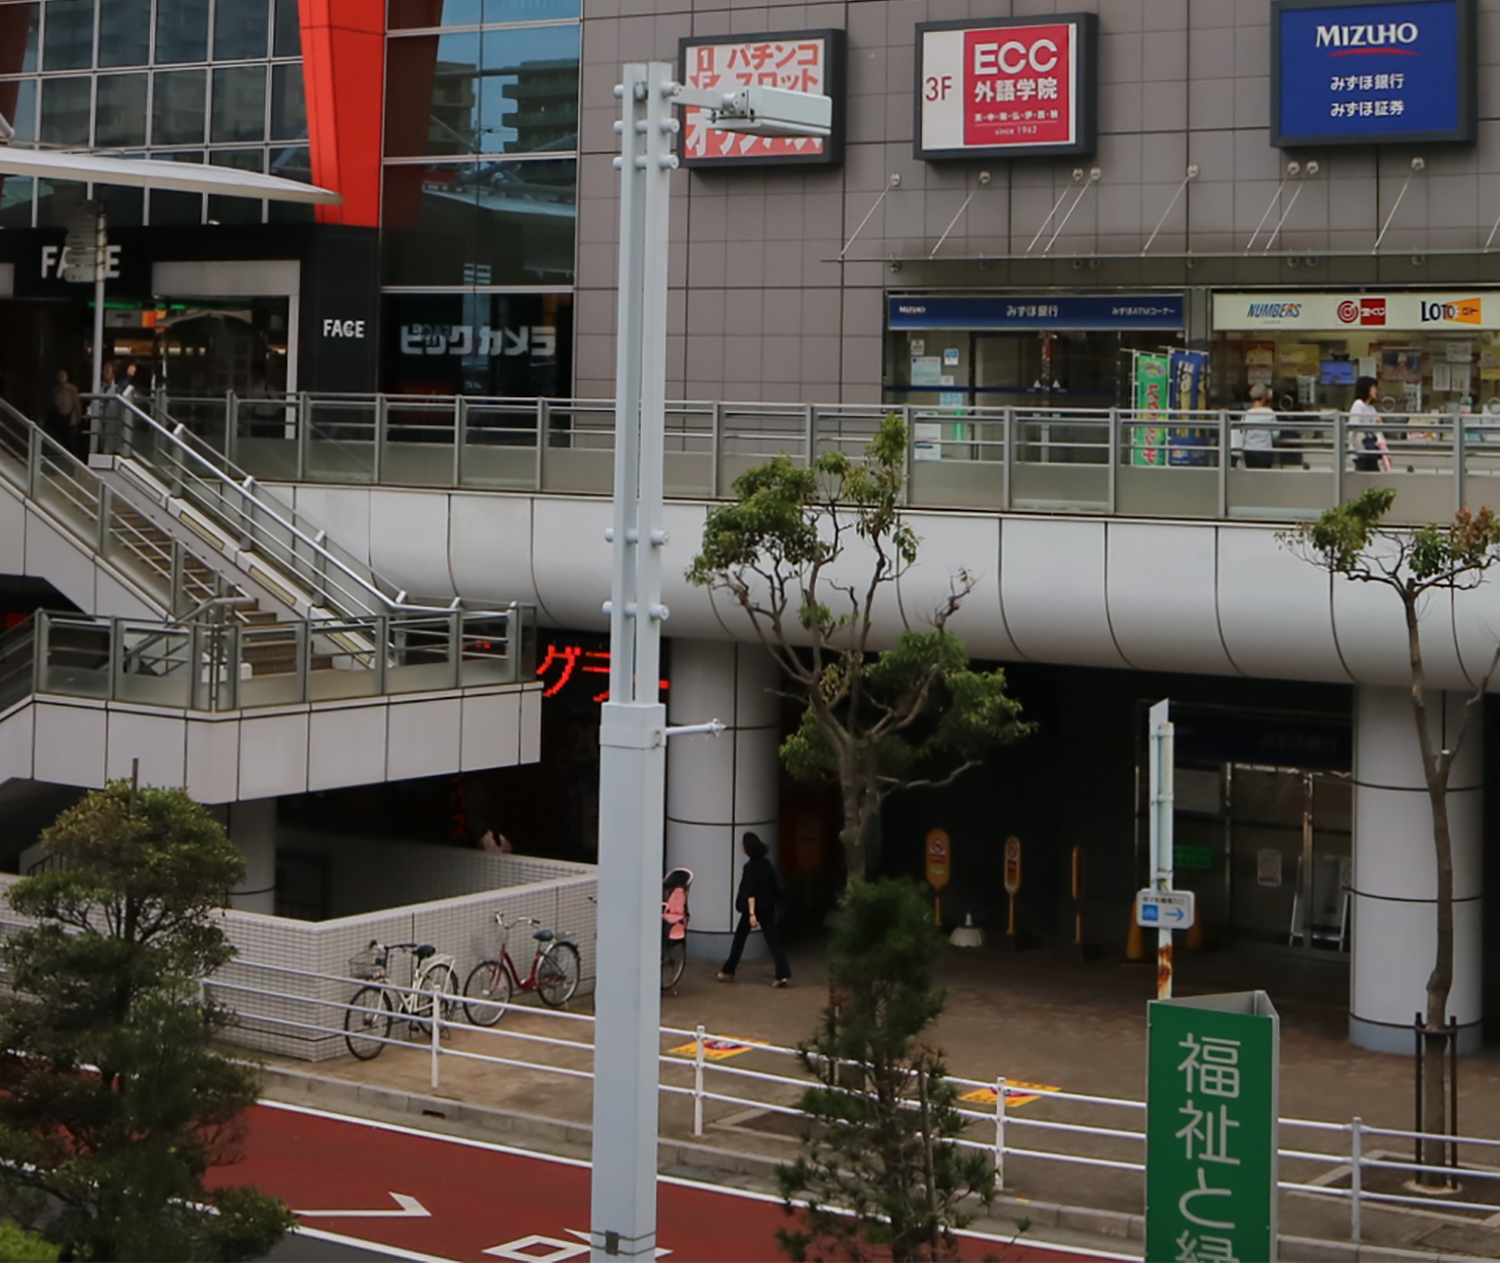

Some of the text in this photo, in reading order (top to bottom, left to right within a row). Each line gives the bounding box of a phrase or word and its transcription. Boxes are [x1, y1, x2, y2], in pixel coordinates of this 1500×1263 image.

[1315, 22, 1419, 48] MIZUHO
[726, 43, 819, 71] パチンコ
[974, 38, 1059, 75] ECC
[925, 75, 953, 102] 3F
[974, 77, 1059, 103] 外語学院
[1330, 73, 1404, 91] みずほ銀行
[1330, 100, 1404, 117] みずほ証券
[41, 245, 121, 279] FE
[1006, 304, 1059, 317] みずほ銀行
[1246, 303, 1303, 319] NUMBERS
[322, 319, 365, 339] FACE
[401, 324, 556, 356] ビックカメラ
